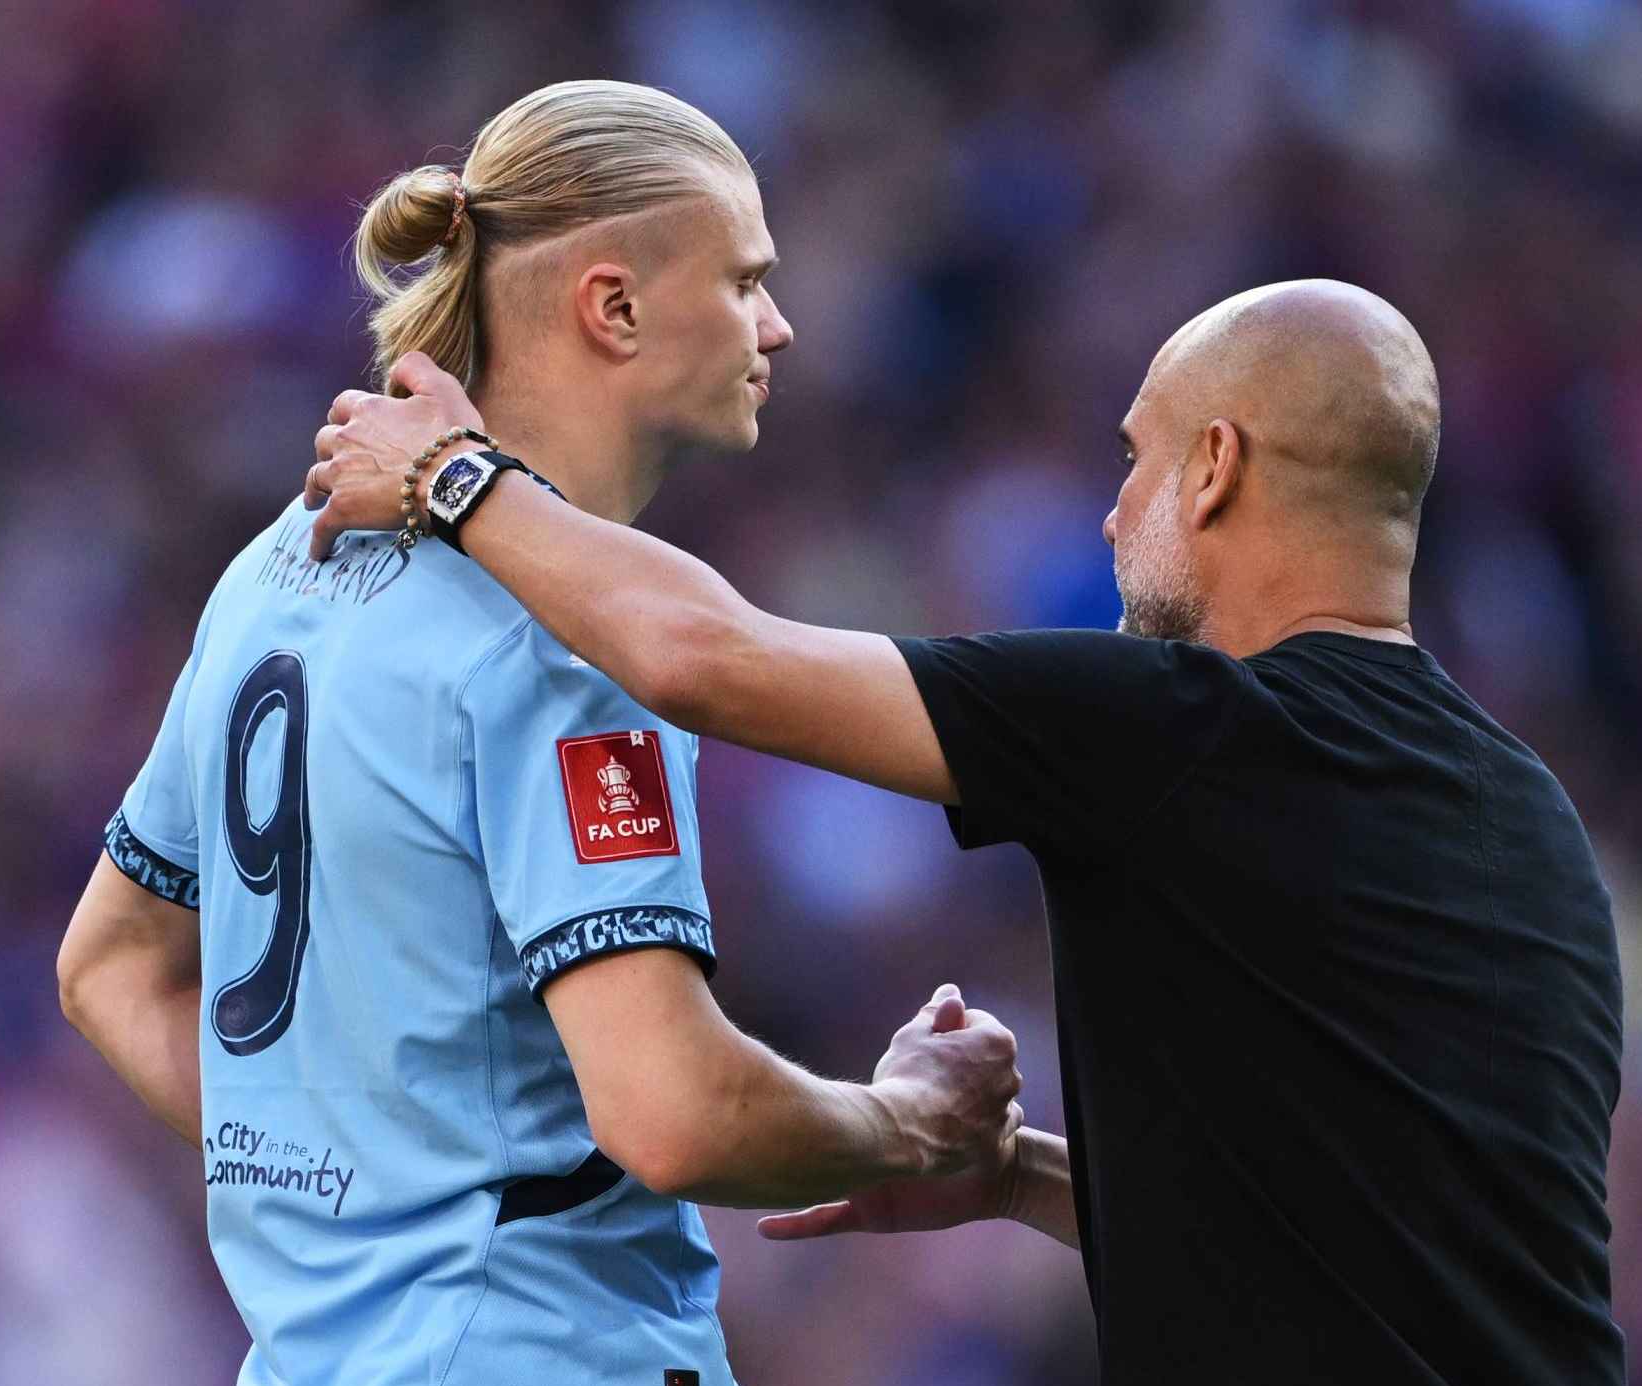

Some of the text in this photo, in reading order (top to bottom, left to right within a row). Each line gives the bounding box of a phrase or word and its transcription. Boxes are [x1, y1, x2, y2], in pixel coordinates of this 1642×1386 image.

[587, 817, 661, 842] FA CUP
[211, 648, 312, 1057] 9
[218, 1121, 309, 1158] City in the
